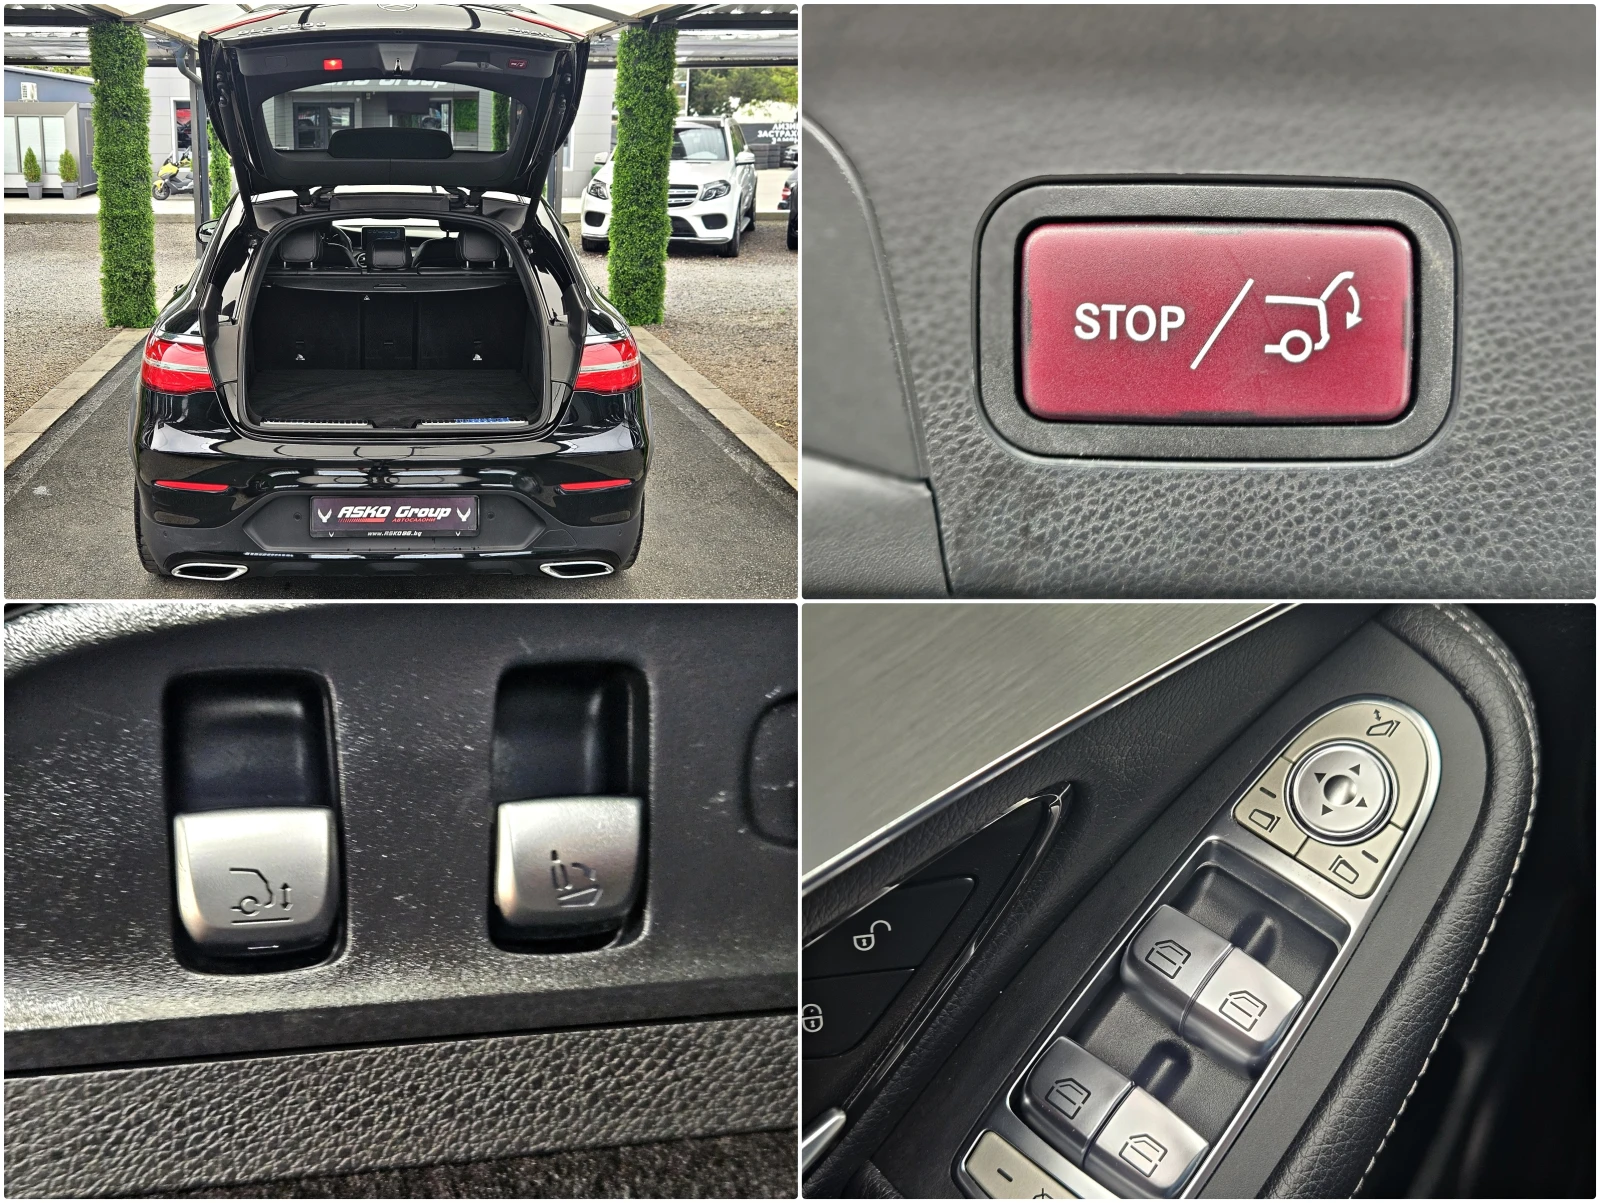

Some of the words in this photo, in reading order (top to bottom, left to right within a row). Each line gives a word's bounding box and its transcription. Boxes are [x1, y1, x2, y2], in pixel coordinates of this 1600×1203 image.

[757, 130, 798, 138] ЗАСТРАХ
[1073, 301, 1186, 342] STOP
[337, 505, 391, 518] ASKO
[394, 505, 452, 520] Group
